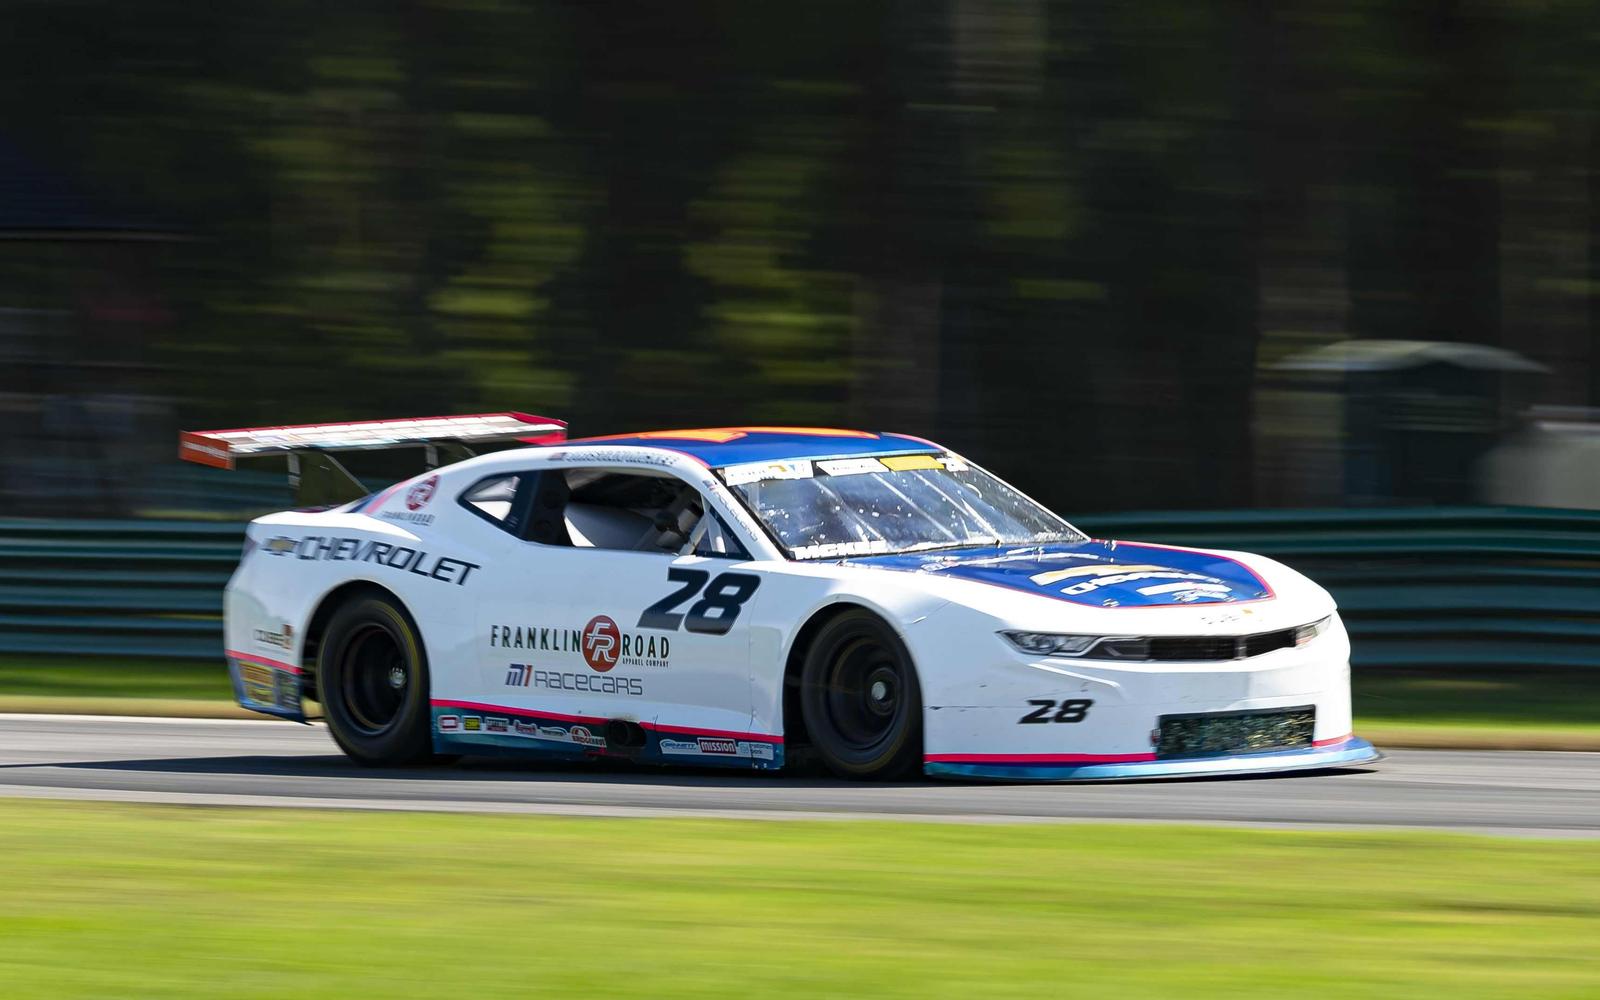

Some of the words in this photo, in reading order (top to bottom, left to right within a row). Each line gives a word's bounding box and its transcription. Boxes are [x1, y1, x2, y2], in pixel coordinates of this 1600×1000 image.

[297, 536, 481, 586] CHEVROLET
[637, 567, 761, 636] 28
[490, 625, 581, 652] FRANKLIN
[622, 634, 670, 659] ROAD
[622, 657, 644, 667] APPAREL
[646, 660, 669, 668] COMPANY
[1016, 699, 1096, 724] 28
